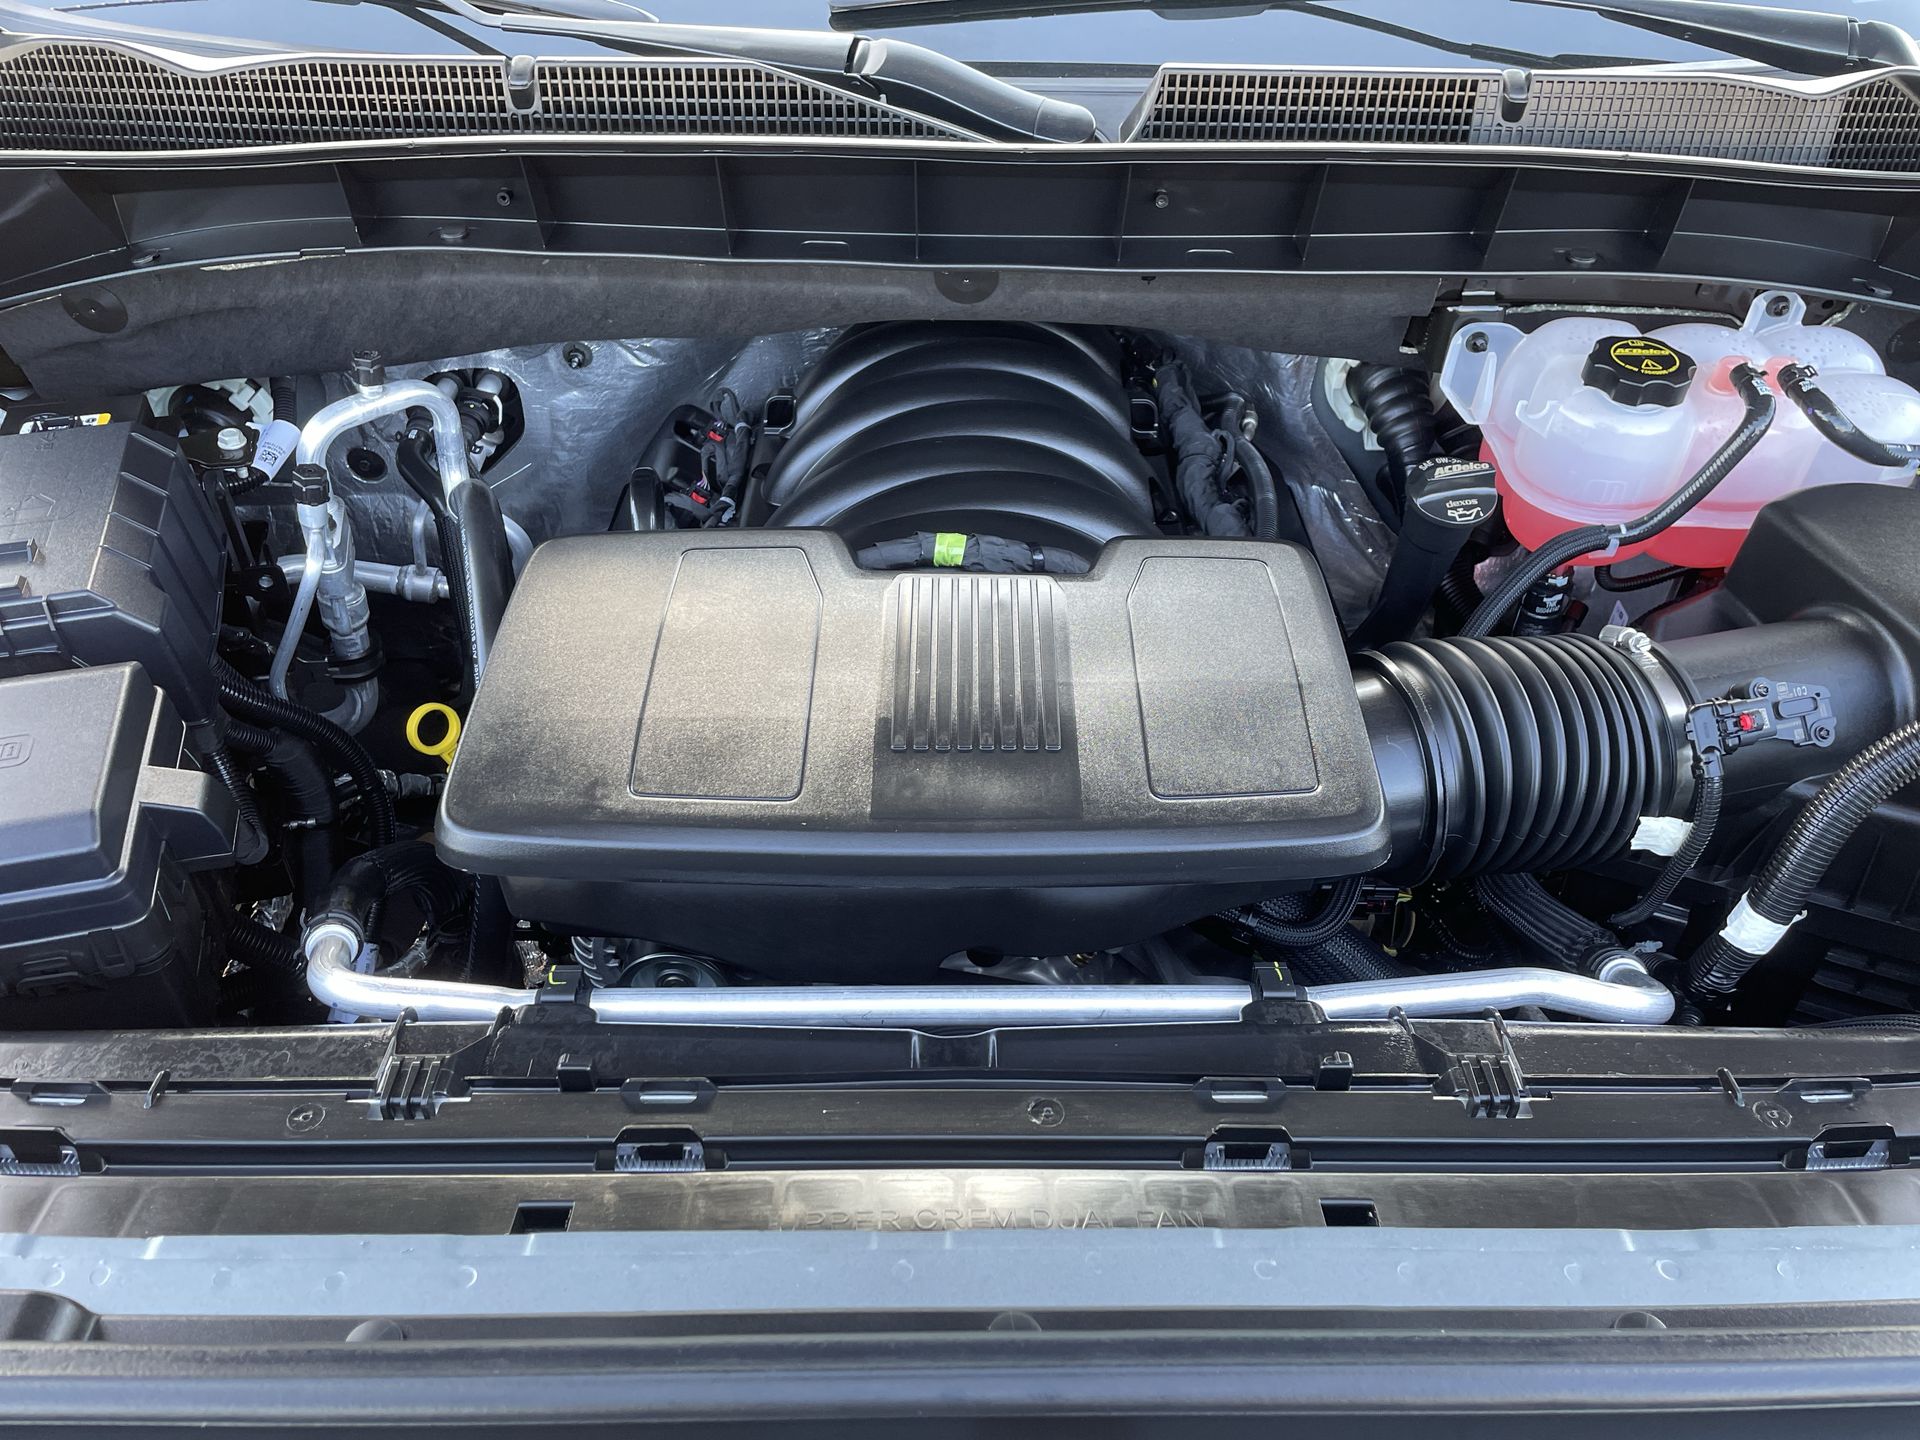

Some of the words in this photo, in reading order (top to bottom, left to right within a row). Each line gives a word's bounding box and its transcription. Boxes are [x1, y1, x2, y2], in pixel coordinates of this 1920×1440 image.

[1614, 348, 1670, 356] ACDelco
[1418, 459, 1435, 471] SAE
[1434, 463, 1490, 476] ACDelco
[1445, 499, 1479, 508] dexos
[1135, 1208, 1205, 1229] FAN
